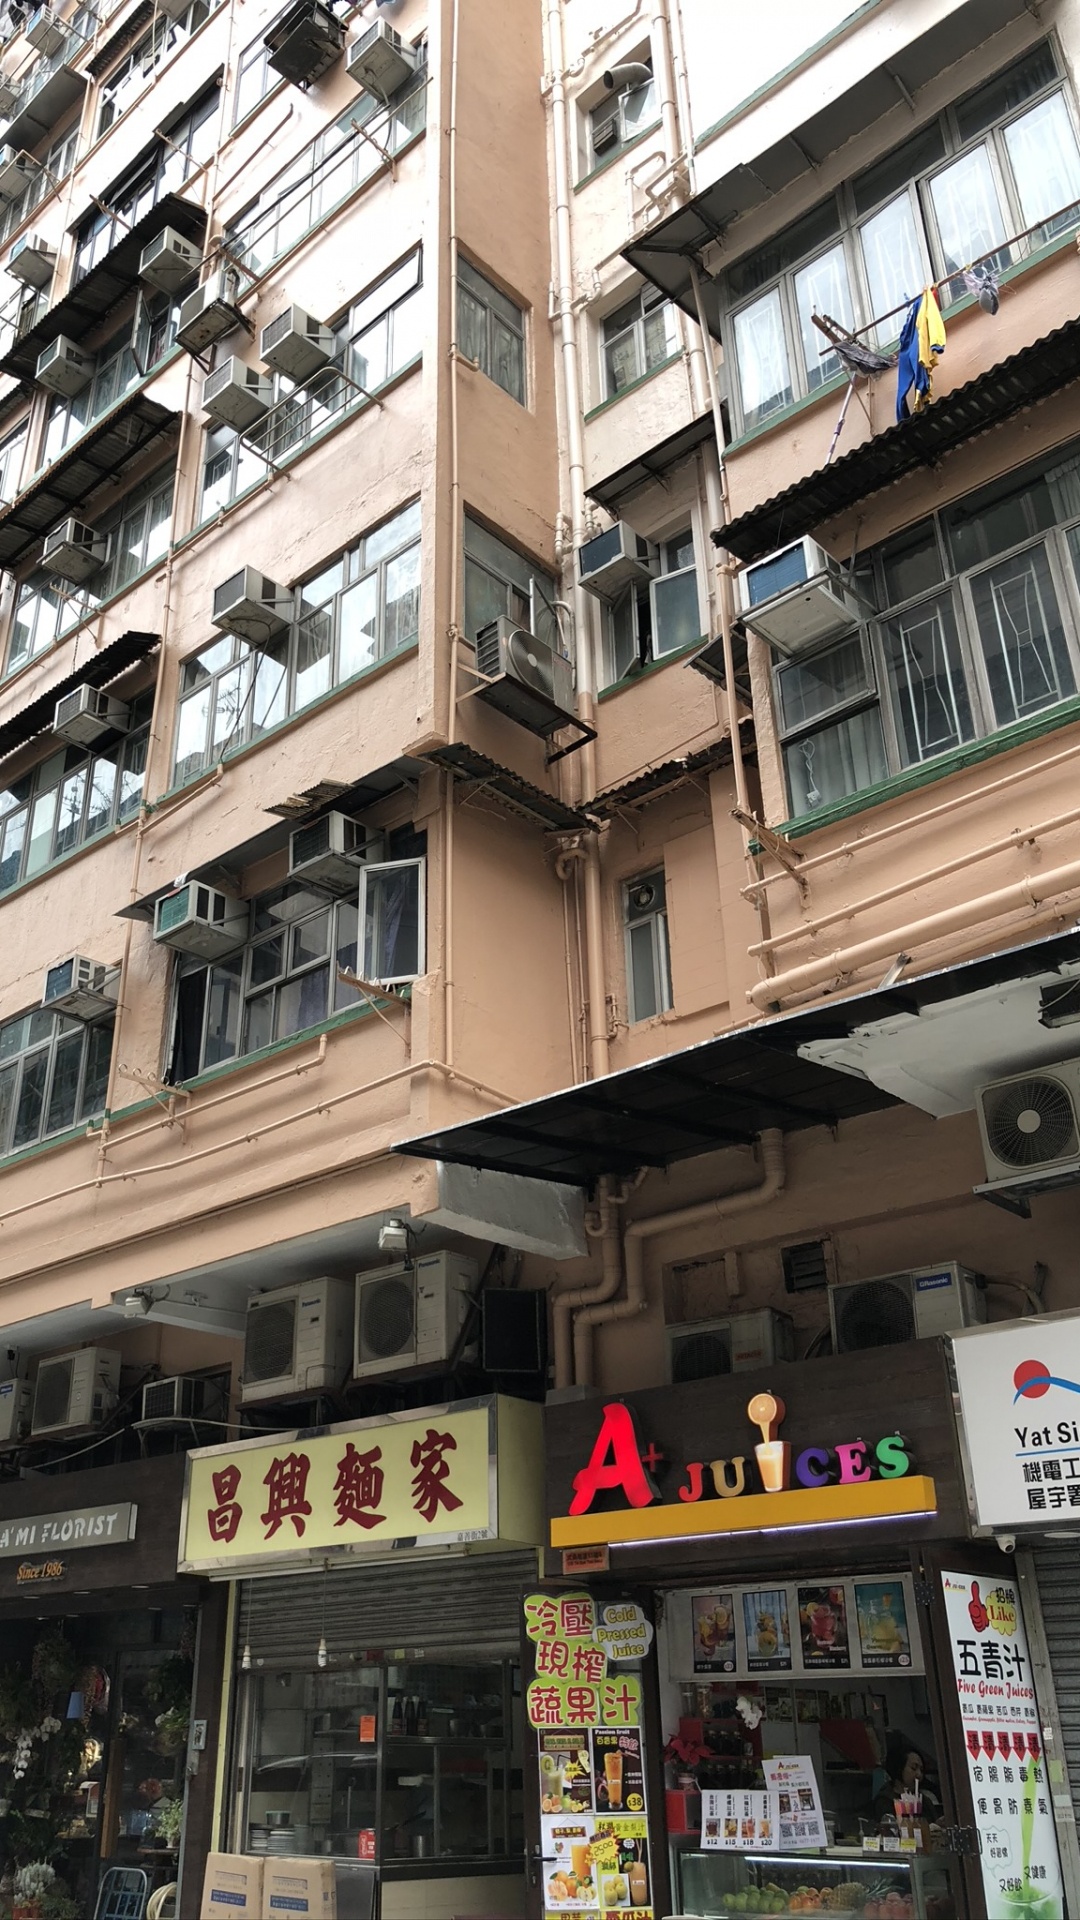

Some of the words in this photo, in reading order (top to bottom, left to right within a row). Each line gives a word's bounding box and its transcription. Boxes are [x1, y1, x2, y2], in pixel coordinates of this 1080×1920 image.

[1014, 1426, 1052, 1448] Yat
[1022, 1457, 1080, 1483] 機電工
[207, 1428, 464, 1543] 昌興麵家
[1027, 1484, 1080, 1510] 屋宇署
[41, 1512, 118, 1543] FLORIST
[17, 1562, 39, 1580] Since
[41, 1560, 63, 1578] 1986
[526, 1598, 594, 1637] 冷壓
[605, 1605, 637, 1624] Cold
[989, 1604, 1015, 1623] Like
[596, 1623, 647, 1643] Pressed
[537, 1640, 606, 1683] 現榨
[612, 1643, 645, 1659] Juice
[956, 1639, 1025, 1682] 五青汁
[957, 1678, 976, 1694] Five
[978, 1680, 1004, 1699] Green
[1005, 1681, 1034, 1699] Juices
[530, 1683, 637, 1724] 蔬果汁
[628, 1798, 642, 1807] $38
[725, 1838, 736, 1846] $15
[986, 1833, 999, 1844] 天天
[1024, 1865, 1047, 1880] 又健康
